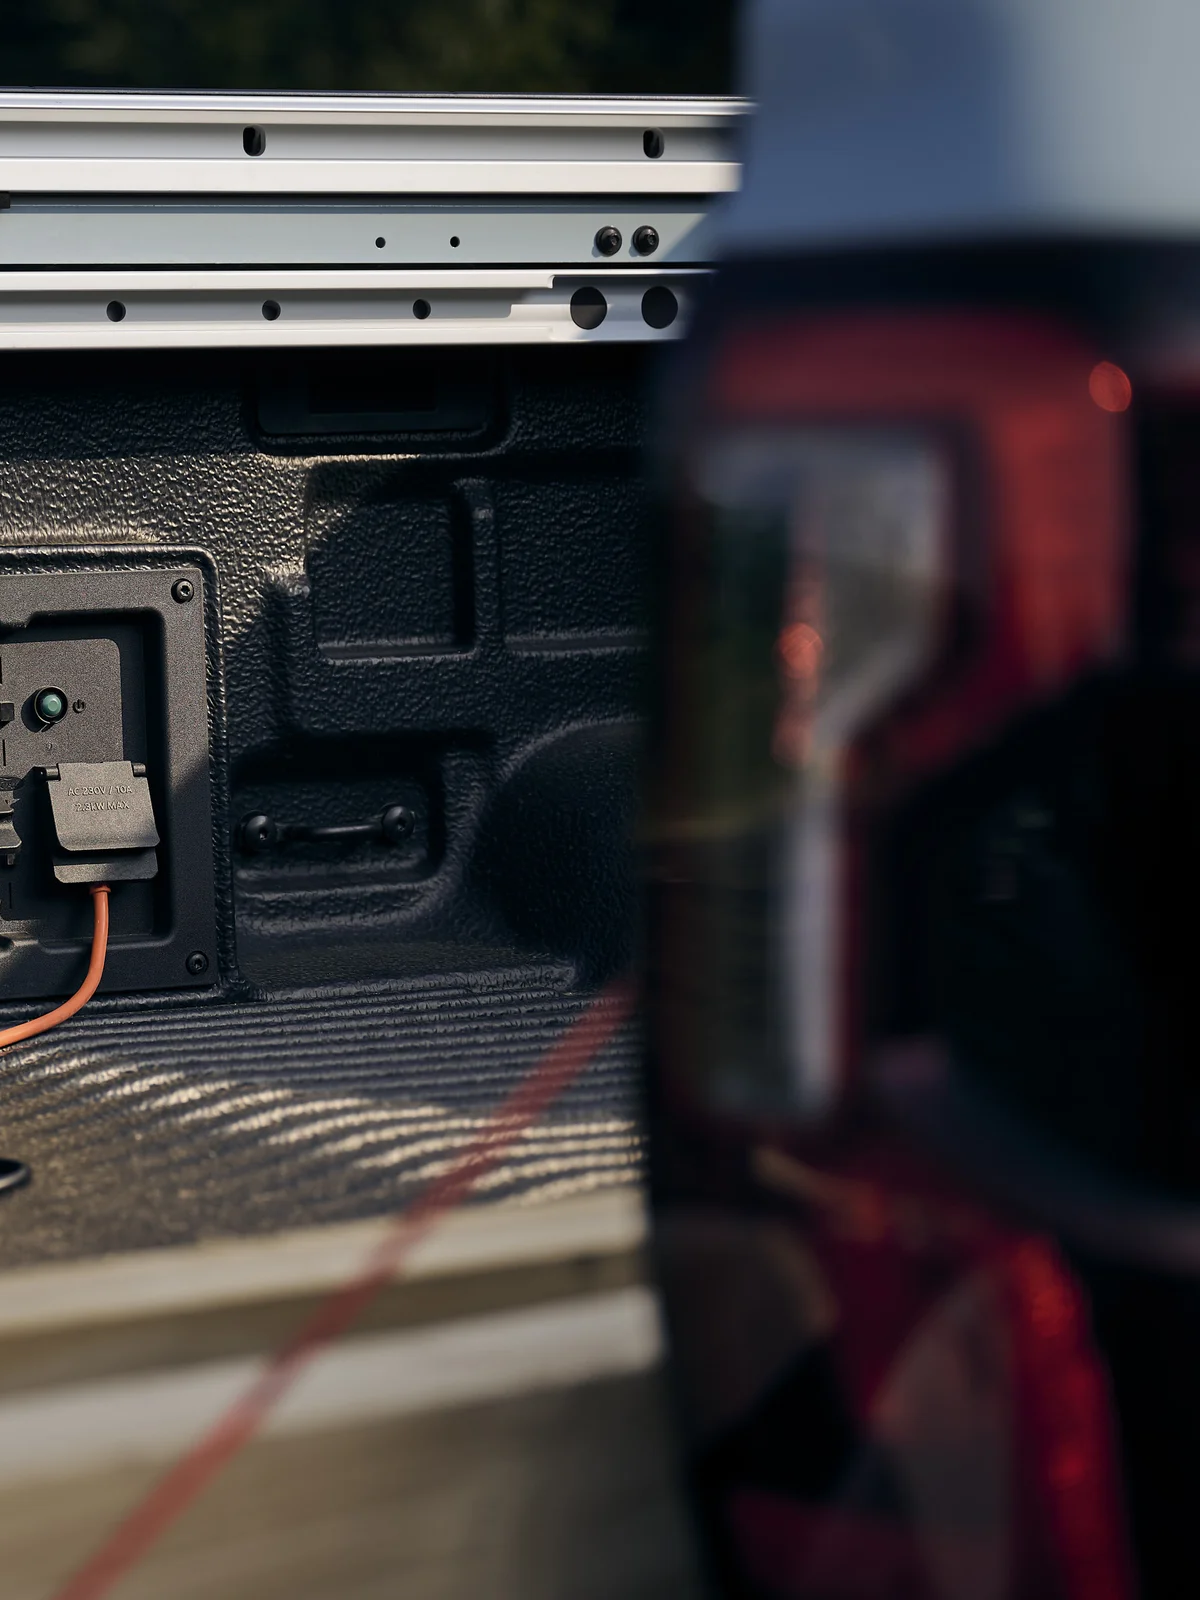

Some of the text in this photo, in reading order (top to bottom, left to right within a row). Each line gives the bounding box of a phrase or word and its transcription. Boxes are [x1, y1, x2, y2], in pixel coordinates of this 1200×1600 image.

[68, 787, 80, 796] AC
[82, 786, 106, 796] 230V
[115, 785, 133, 794] 10A
[107, 801, 130, 811] MAX
